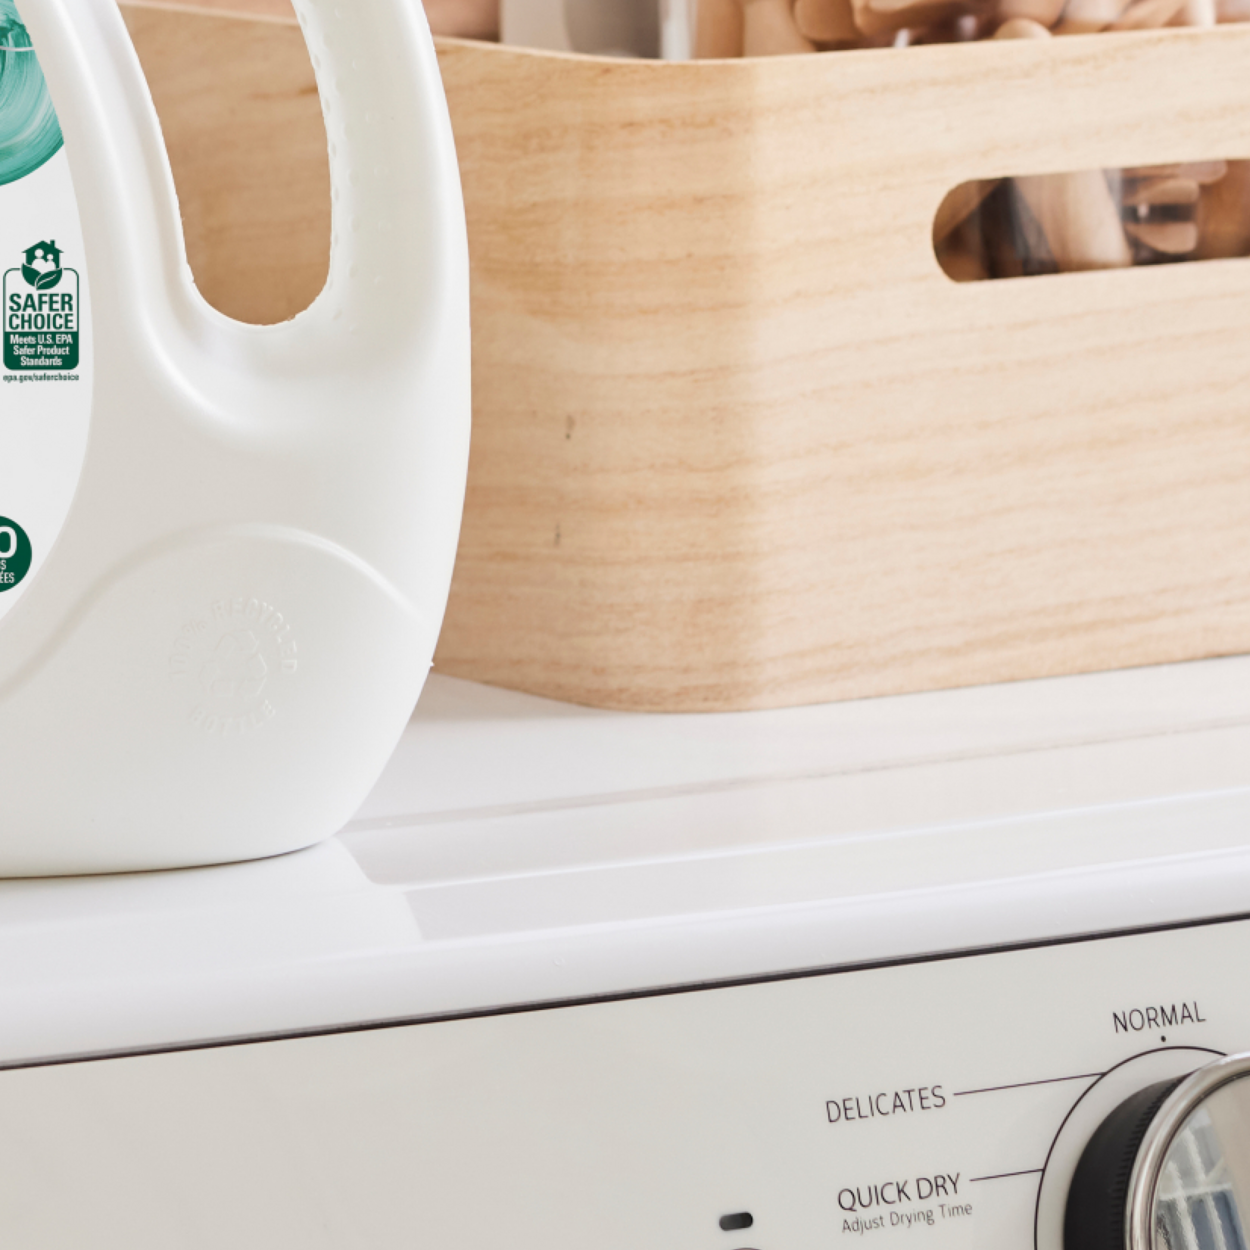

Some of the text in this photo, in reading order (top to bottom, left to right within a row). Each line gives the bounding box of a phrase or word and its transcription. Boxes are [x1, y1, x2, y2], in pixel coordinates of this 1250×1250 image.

[9, 293, 74, 312] SAFER
[9, 313, 74, 330] CHOICE
[10, 334, 73, 345] Meets U.S. EPA
[13, 345, 70, 355] Safer Product
[20, 356, 63, 366] Standards
[1112, 1001, 1206, 1033] NORMAL
[825, 1085, 946, 1123] DELICATES
[837, 1173, 961, 1212] QUICK DRY
[841, 1202, 973, 1235] Adjust Drying Time
